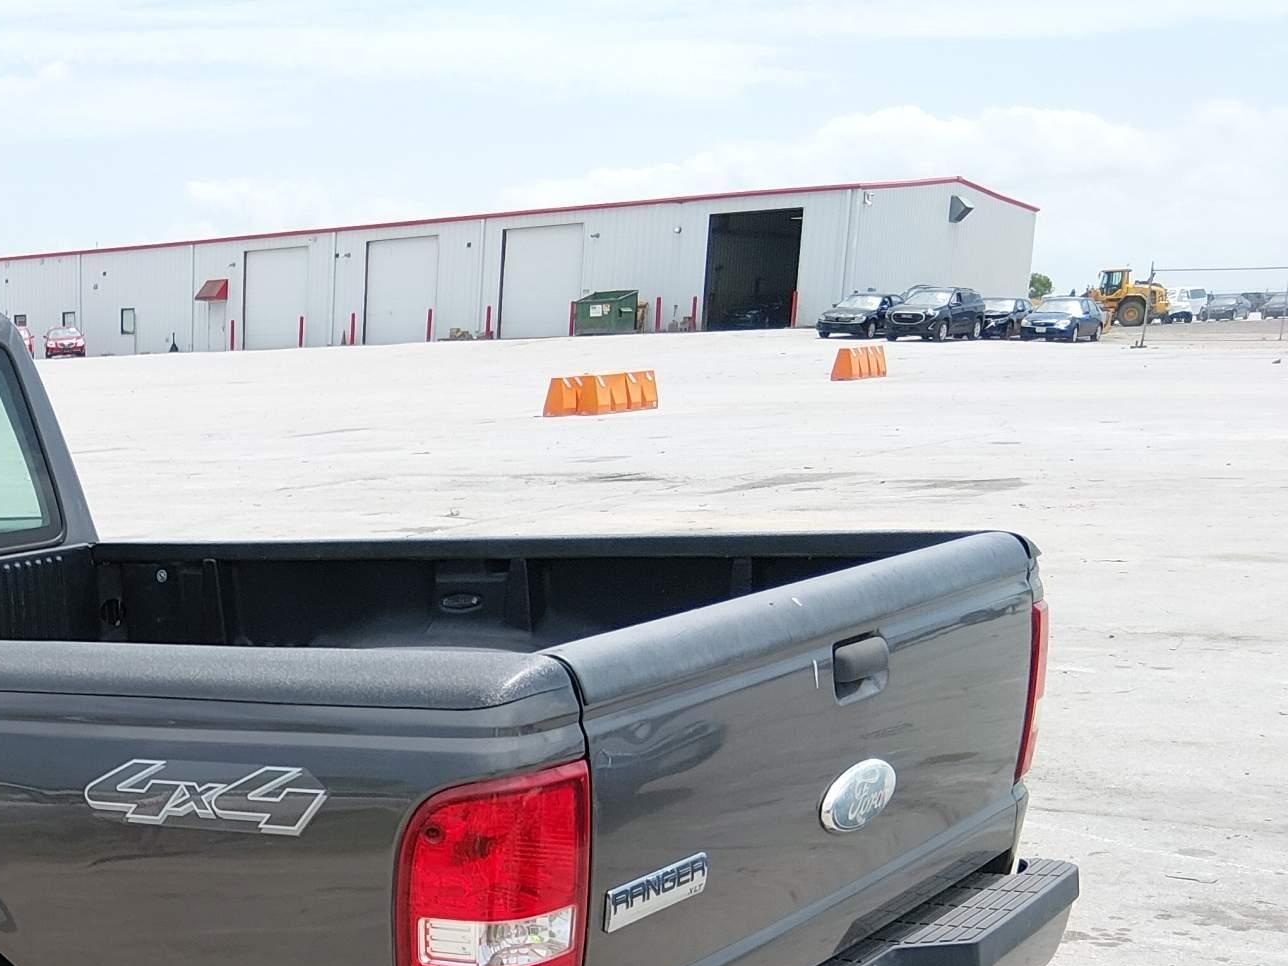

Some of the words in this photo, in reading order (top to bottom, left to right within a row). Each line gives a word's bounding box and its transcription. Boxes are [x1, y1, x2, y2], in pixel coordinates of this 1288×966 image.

[84, 758, 328, 837] 4x4
[612, 856, 707, 916] RANGER
[687, 883, 704, 896] XLT
